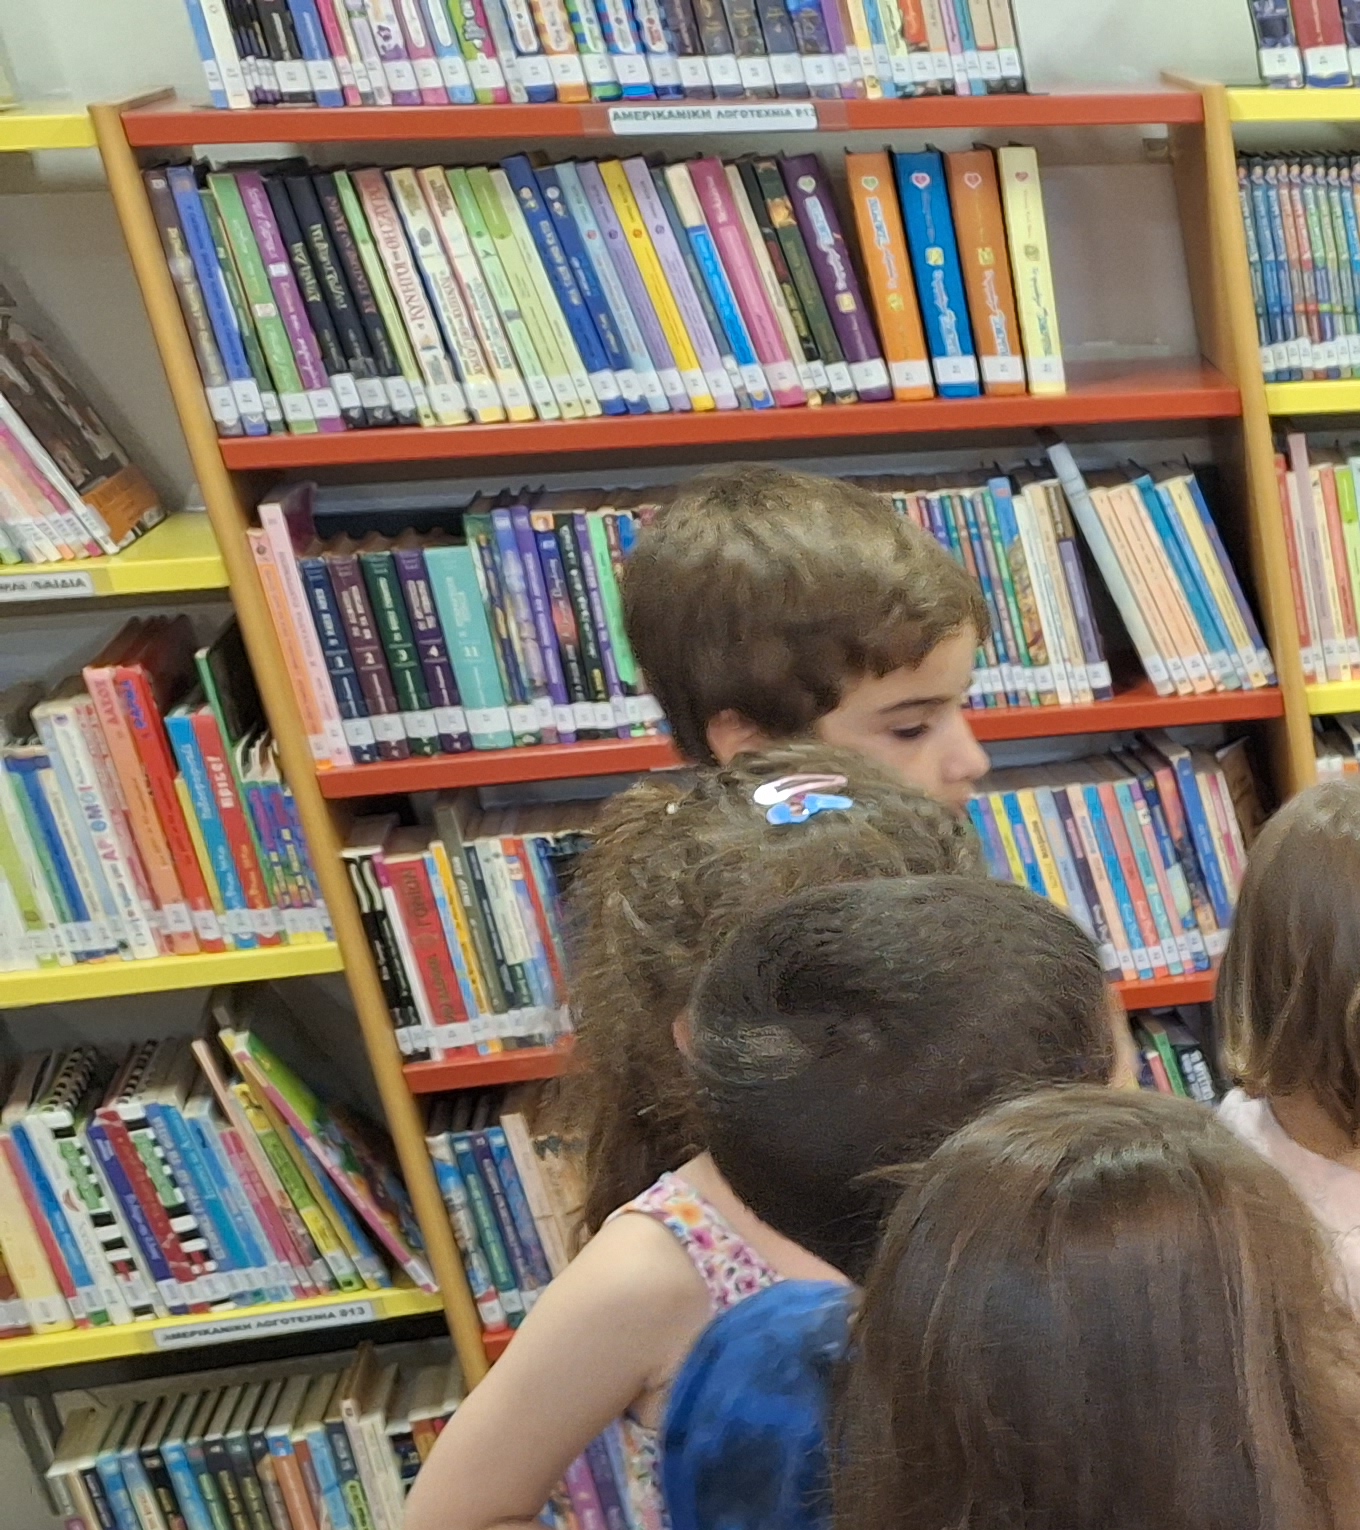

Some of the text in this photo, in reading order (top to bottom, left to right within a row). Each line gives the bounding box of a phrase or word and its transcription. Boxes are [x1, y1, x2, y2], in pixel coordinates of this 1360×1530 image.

[612, 108, 713, 122] ΑΜΕΡΙΚΑΝΙΚΗ
[716, 108, 793, 120] ΛΟΓΟΤΕΧΝΙΑ
[162, 1322, 252, 1342] ΑΜΕΡΙΚΑΝΙΚΗ
[255, 1310, 336, 1329] ΛΟΓΟΤΕΧΝΙΑ
